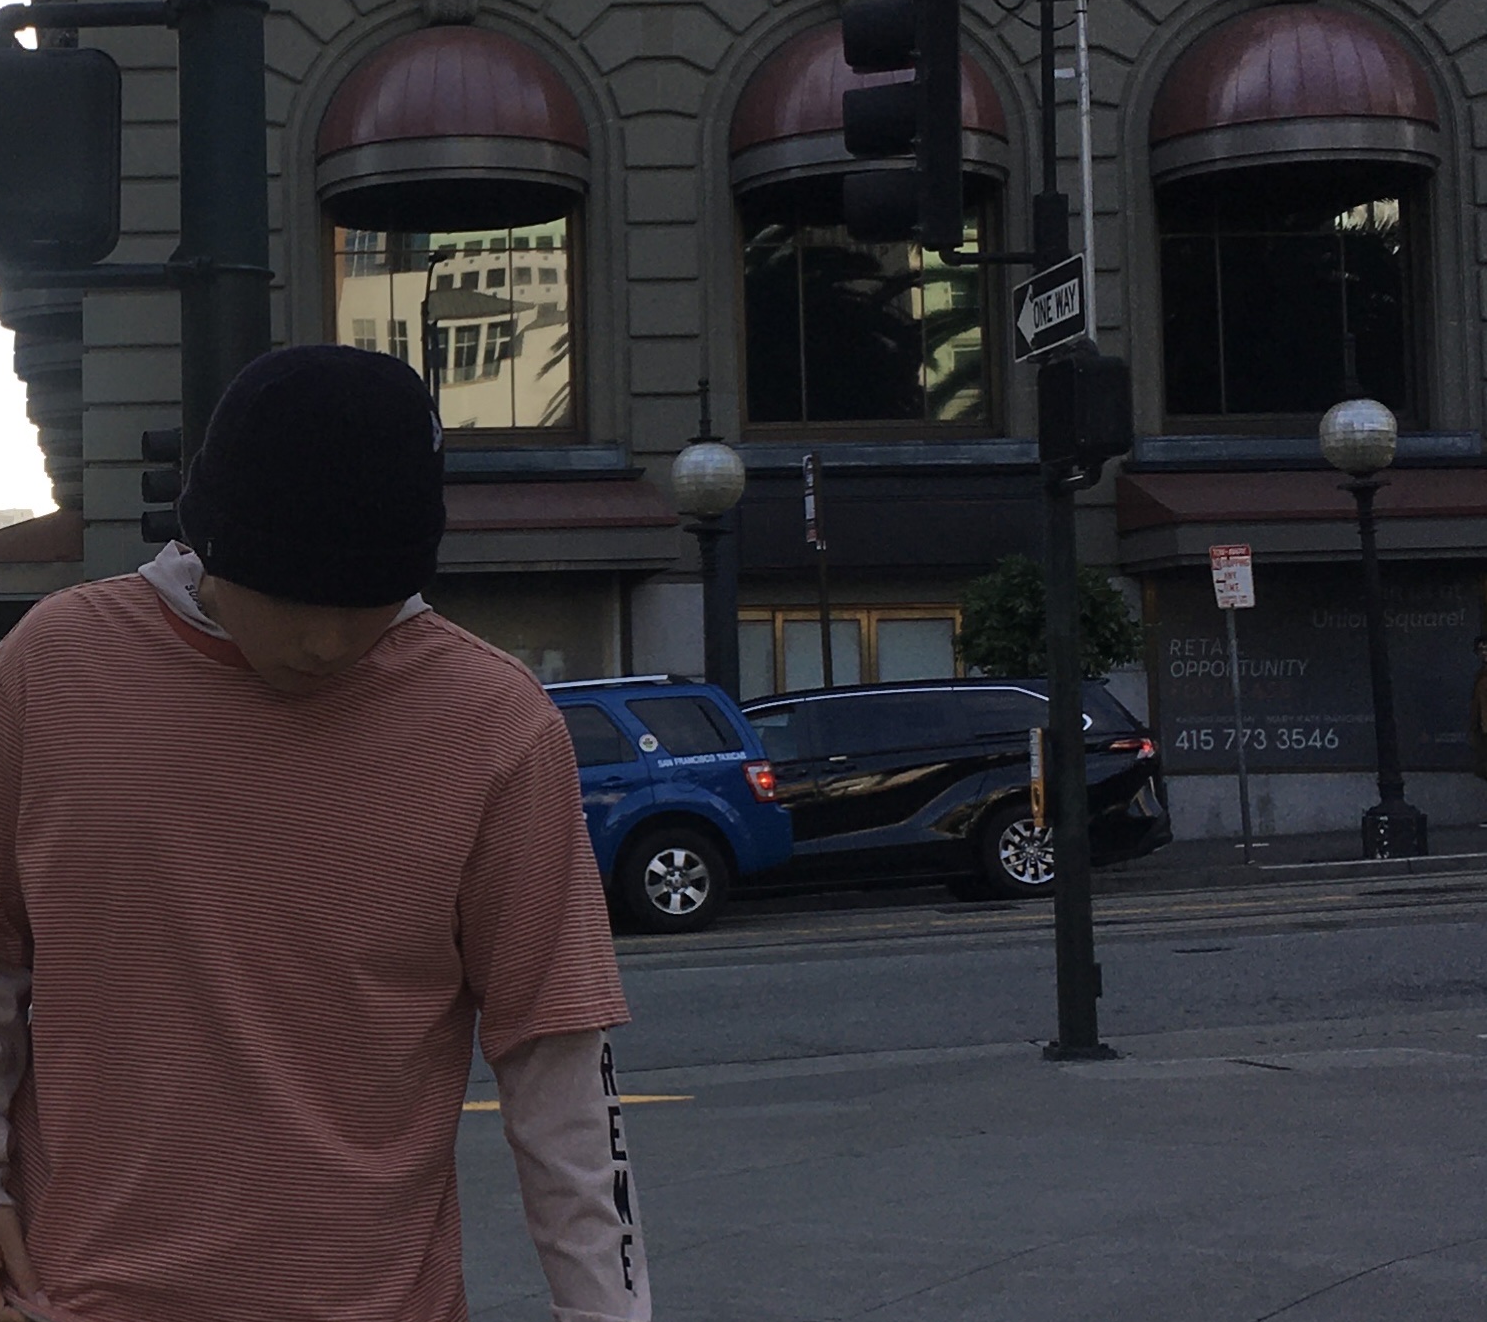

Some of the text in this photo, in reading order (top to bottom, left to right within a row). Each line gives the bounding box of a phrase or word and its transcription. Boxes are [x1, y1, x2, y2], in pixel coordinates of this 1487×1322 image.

[1034, 283, 1075, 329] ONE WAY
[1175, 729, 1339, 751] 415 773 3546
